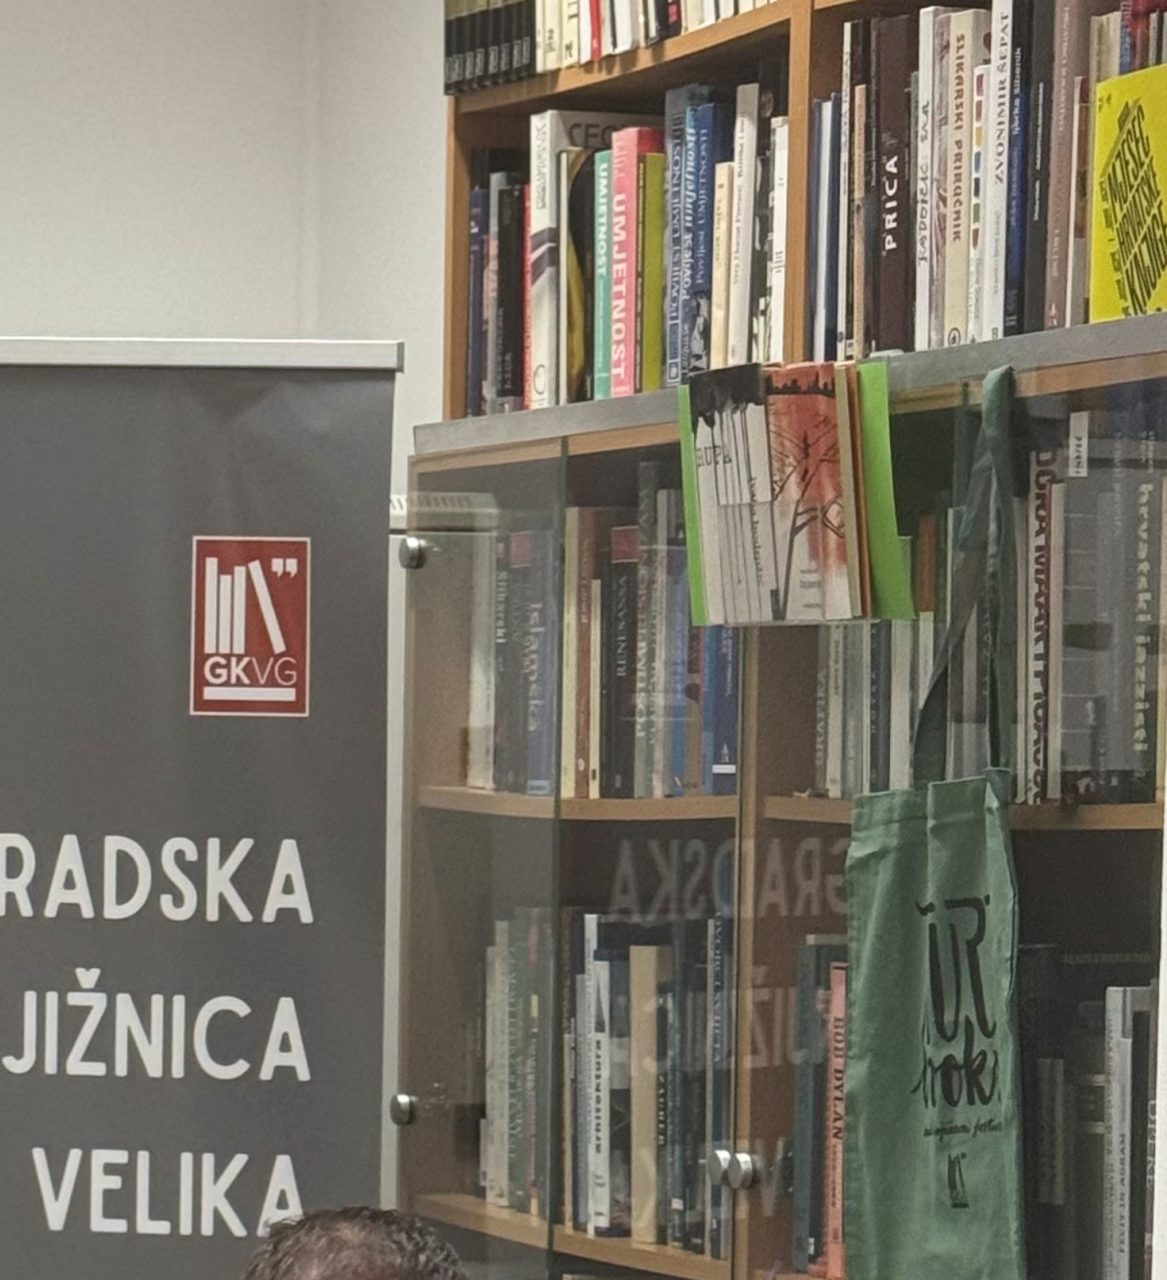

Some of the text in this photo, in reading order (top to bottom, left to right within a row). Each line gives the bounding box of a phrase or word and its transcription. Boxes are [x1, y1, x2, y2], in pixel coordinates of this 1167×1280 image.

[952, 33, 965, 243] SLIKARSKI PRIRUČNIK
[994, 12, 1010, 185] ZVONIMIR ŠEPAT
[884, 155, 898, 252] PRICA
[1107, 103, 1151, 226] MJESEC
[596, 163, 608, 277] UMJETNOST
[682, 234, 696, 300] Povijest
[611, 192, 627, 380] UMJETNOST
[668, 250, 680, 320] POVIJEST
[203, 656, 298, 686] GKVG
[834, 1016, 845, 1059] BOB
[32, 1147, 305, 1238] VELIKA
